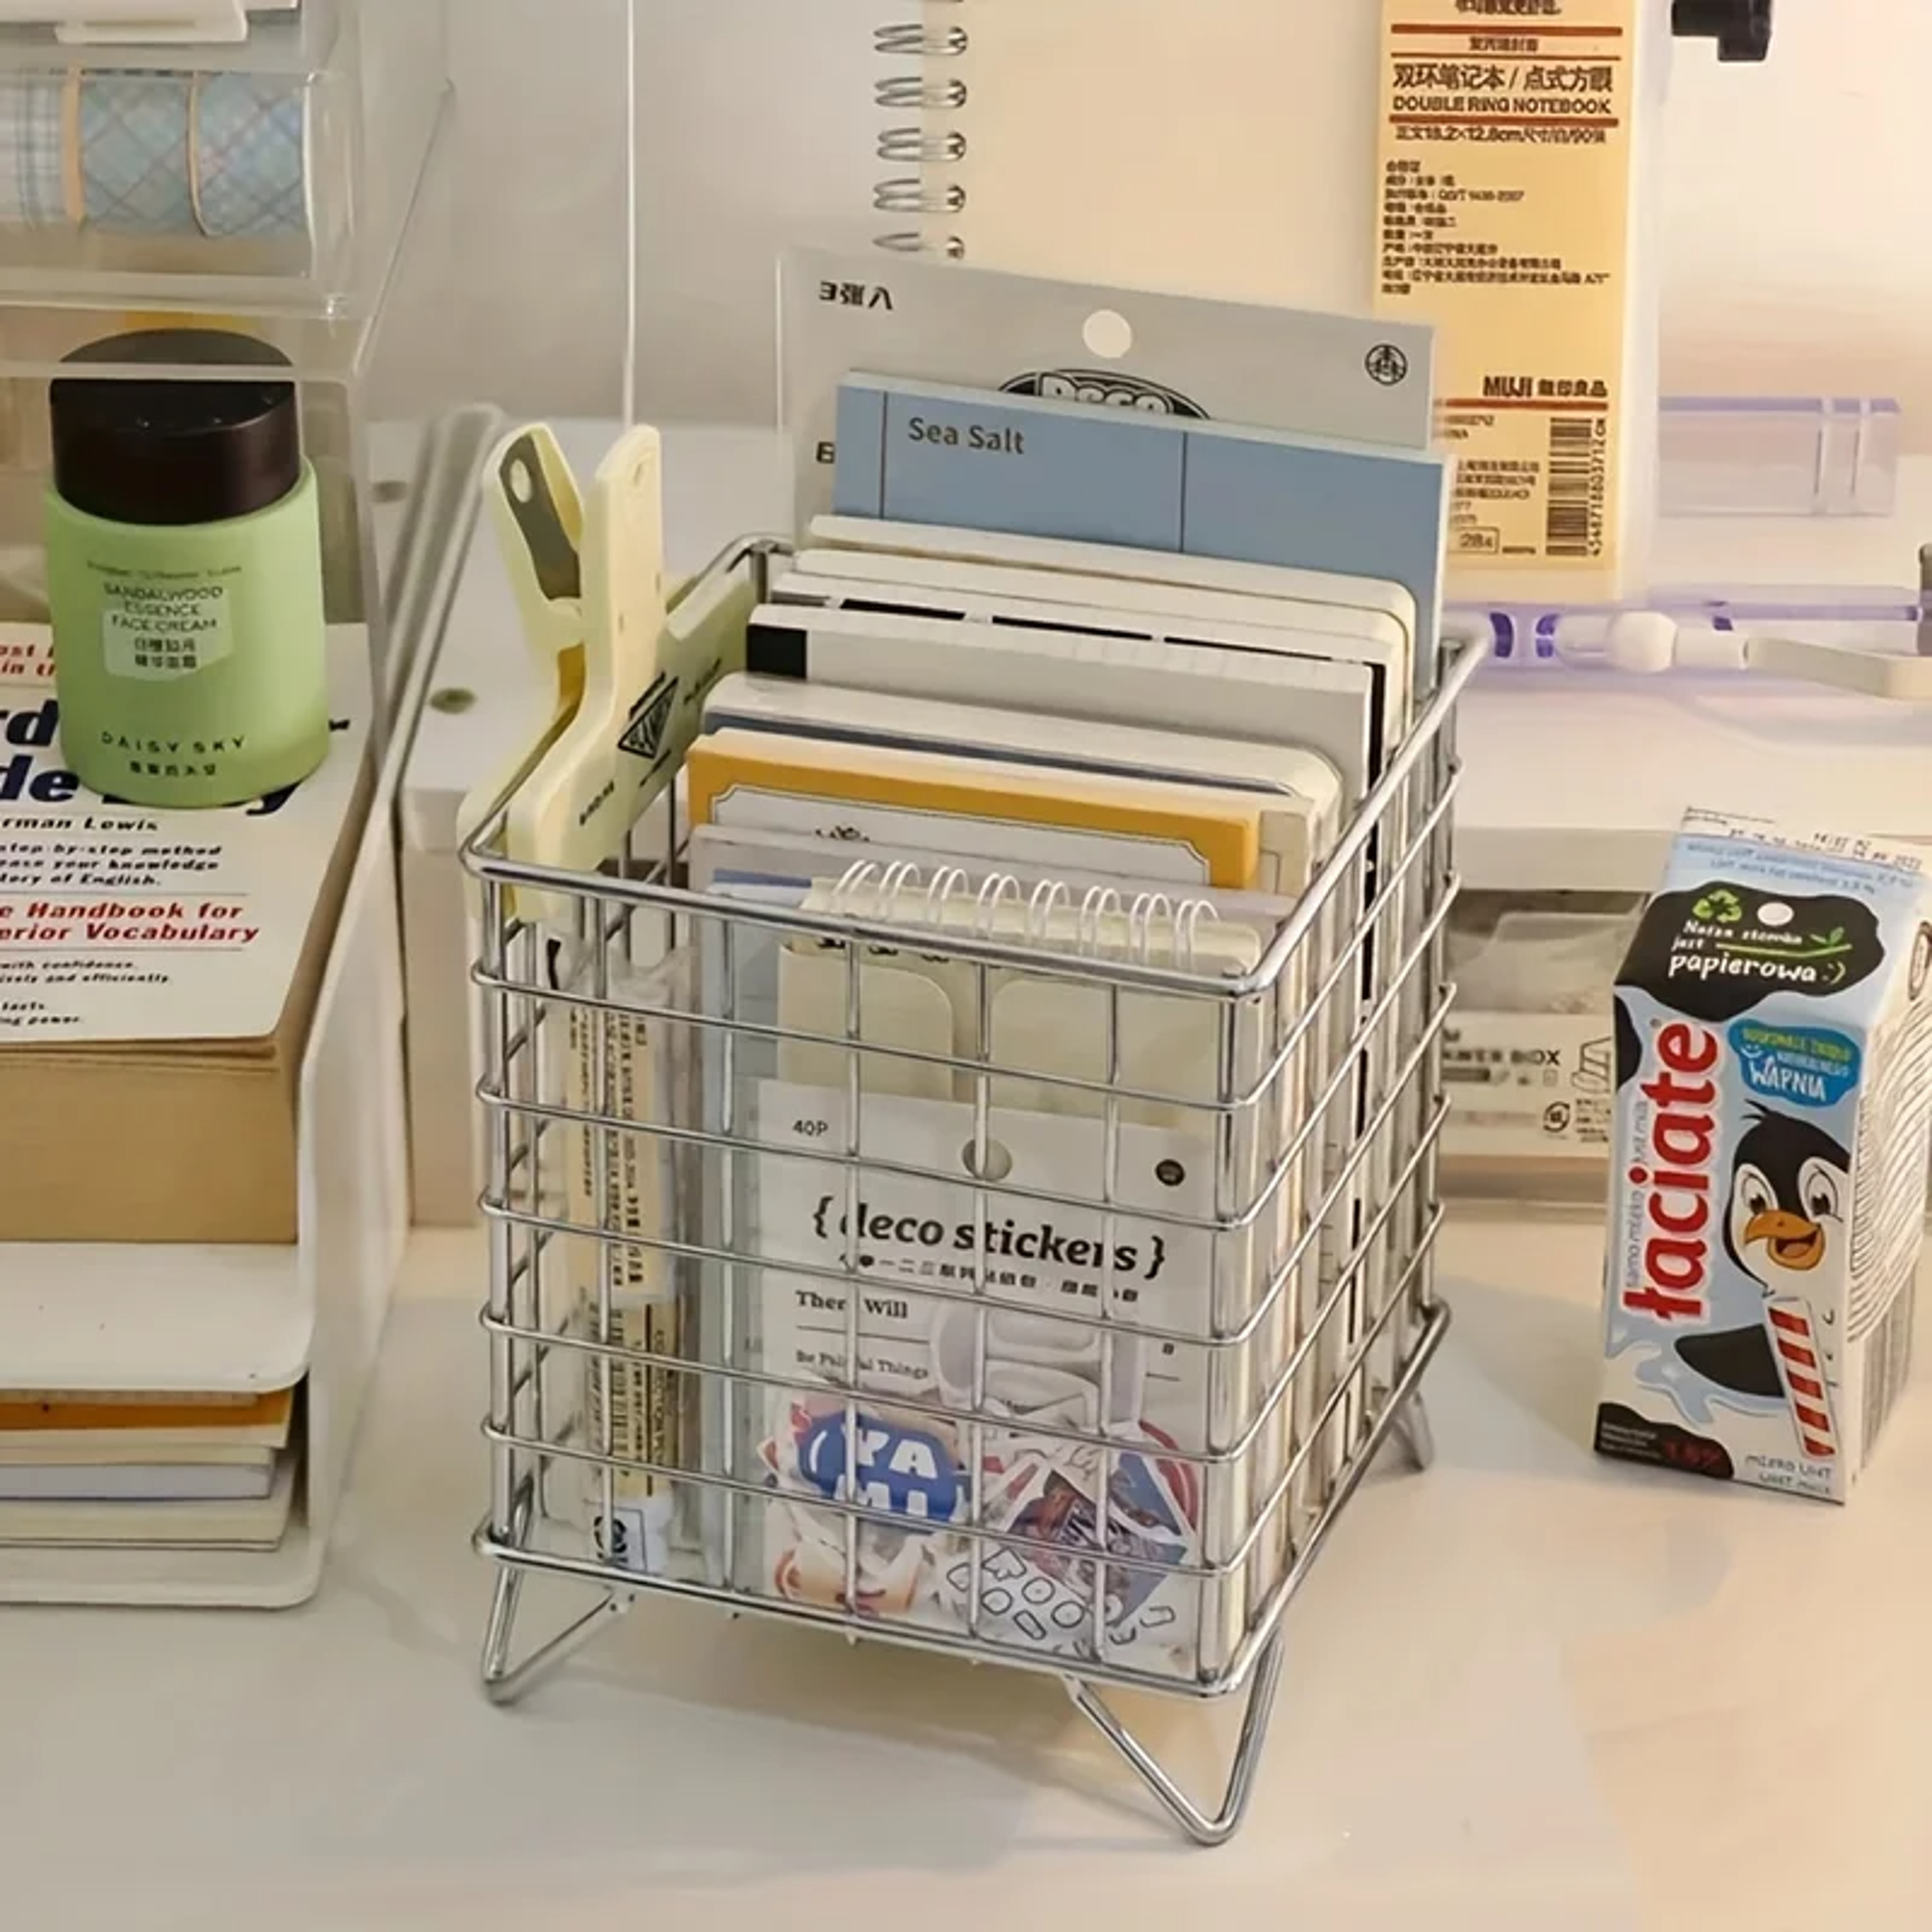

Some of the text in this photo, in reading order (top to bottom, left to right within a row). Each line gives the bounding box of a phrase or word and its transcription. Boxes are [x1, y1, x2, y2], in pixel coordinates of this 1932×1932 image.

[1393, 96, 1612, 114] DOUBLE RING NOTEBOOK
[1483, 376, 1533, 396] MUJI
[909, 417, 1024, 454] Sea Salt
[27, 902, 183, 920] Handbook
[198, 904, 243, 919] for
[86, 924, 259, 944] Vocabulary
[1667, 951, 1817, 982] papierowa
[1748, 1055, 1827, 1102] WAPNIA
[865, 1299, 909, 1319] Will
